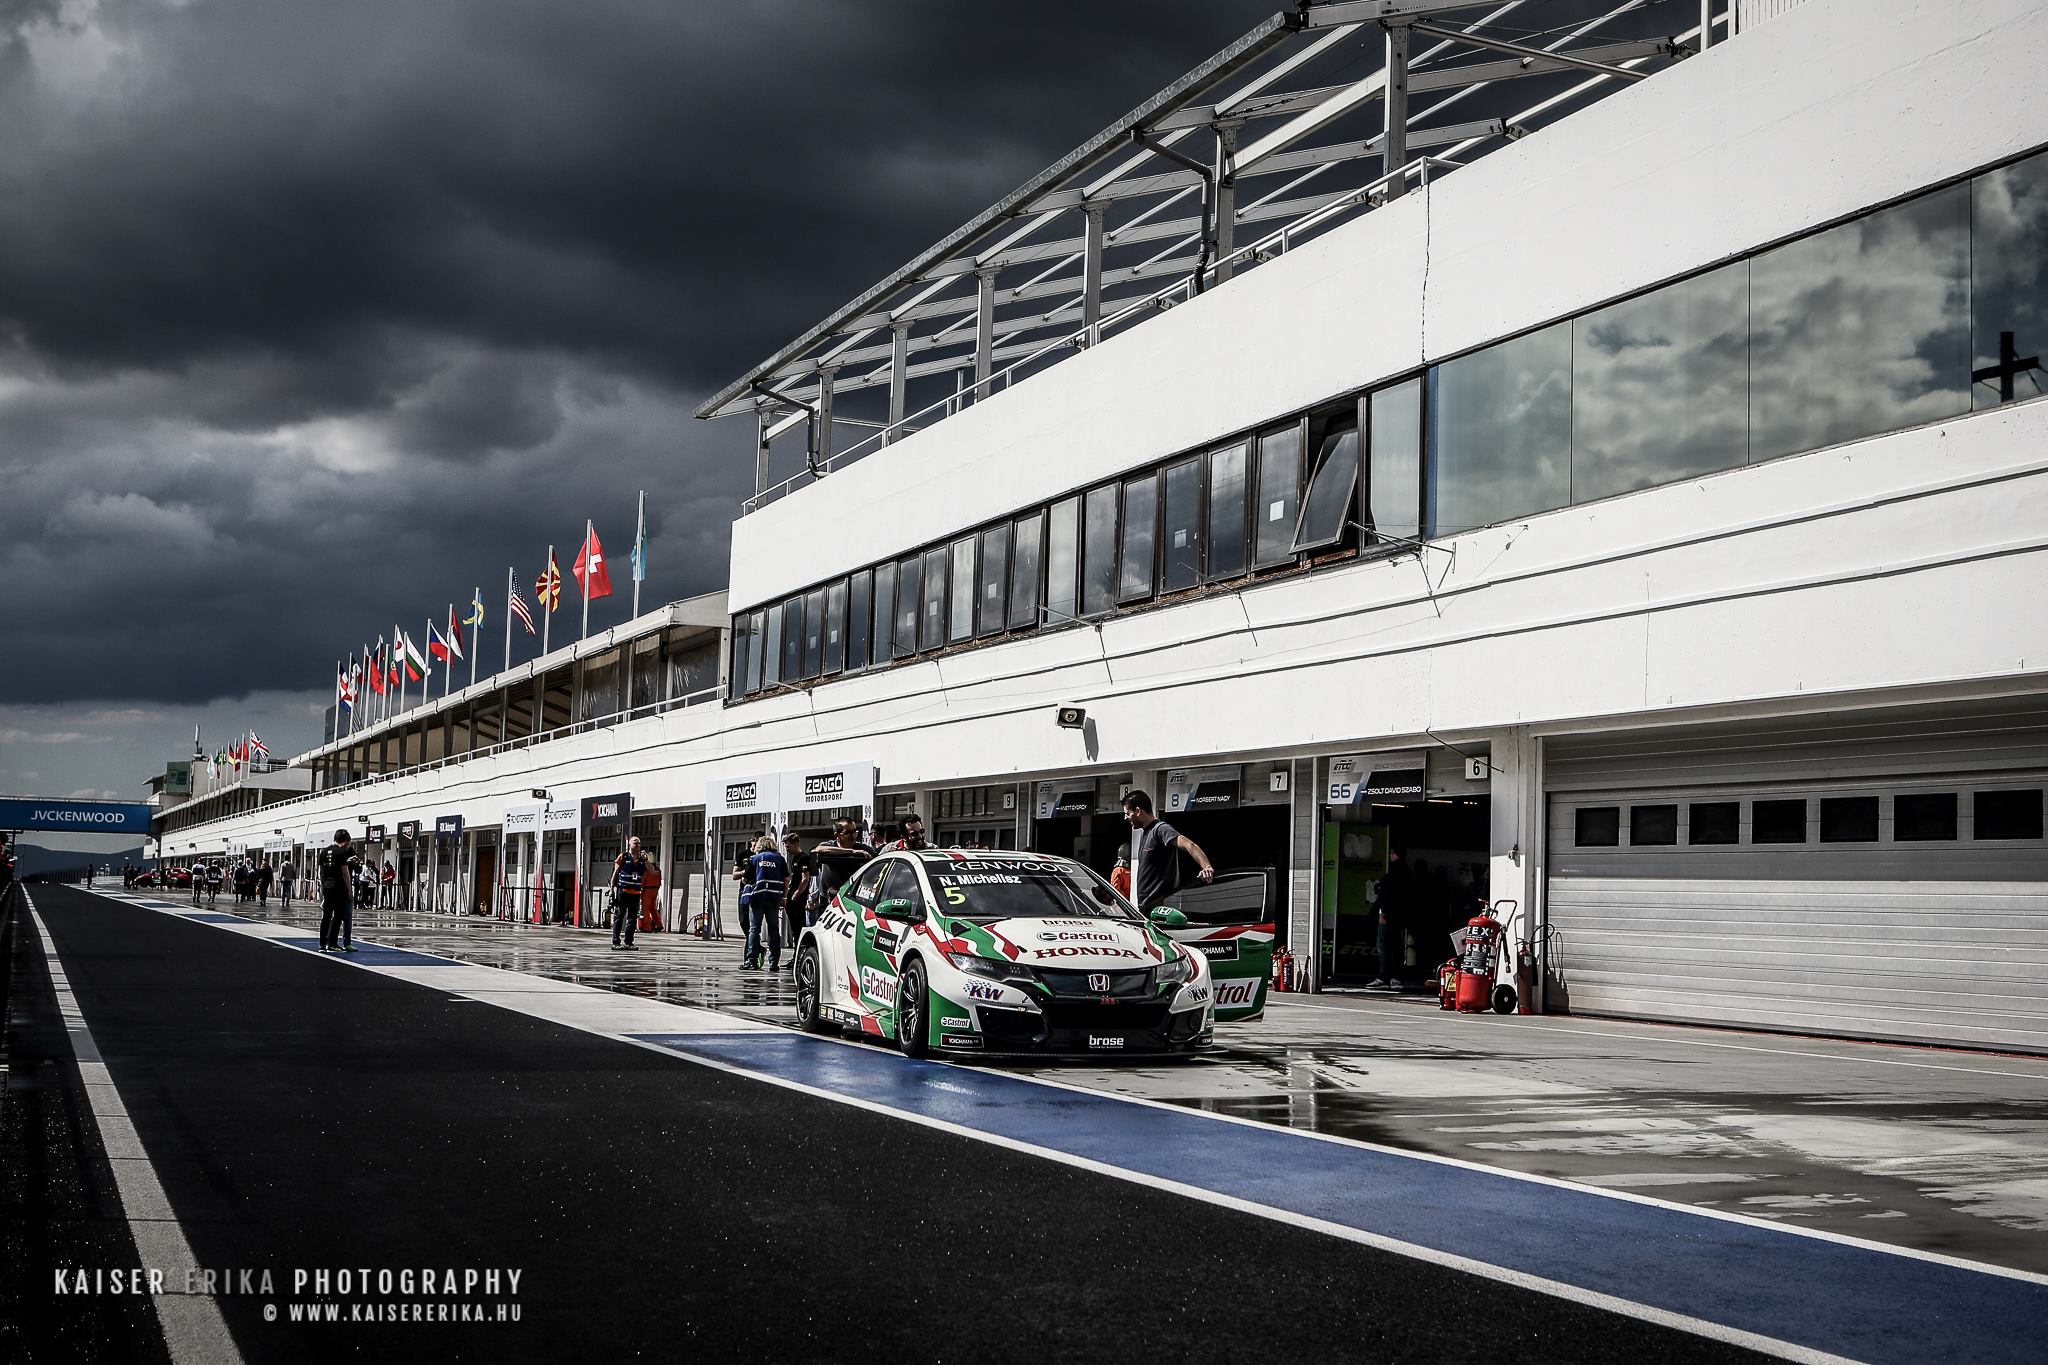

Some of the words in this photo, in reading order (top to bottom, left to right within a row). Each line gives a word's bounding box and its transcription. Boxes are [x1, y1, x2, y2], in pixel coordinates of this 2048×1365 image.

[1472, 761, 1480, 776] 6
[1276, 775, 1281, 789] 7
[1330, 783, 1351, 799] 66
[726, 800, 756, 809] MOTORSPORT
[805, 793, 843, 803] MOTORSPORT
[1006, 796, 1011, 806] 9
[1171, 793, 1180, 807] 8
[31, 810, 125, 823] JVCKENWOOD
[758, 860, 776, 868] MEDIA
[949, 861, 1073, 874] KENWOOD
[938, 875, 956, 887] N.
[943, 887, 966, 905] 5
[1058, 932, 1116, 942] Castrol
[1033, 947, 1143, 960] HONDA
[969, 985, 1005, 1001] KW
[1192, 986, 1209, 1001] KW
[947, 1018, 969, 1027] Castrol
[1089, 1035, 1124, 1046] brose
